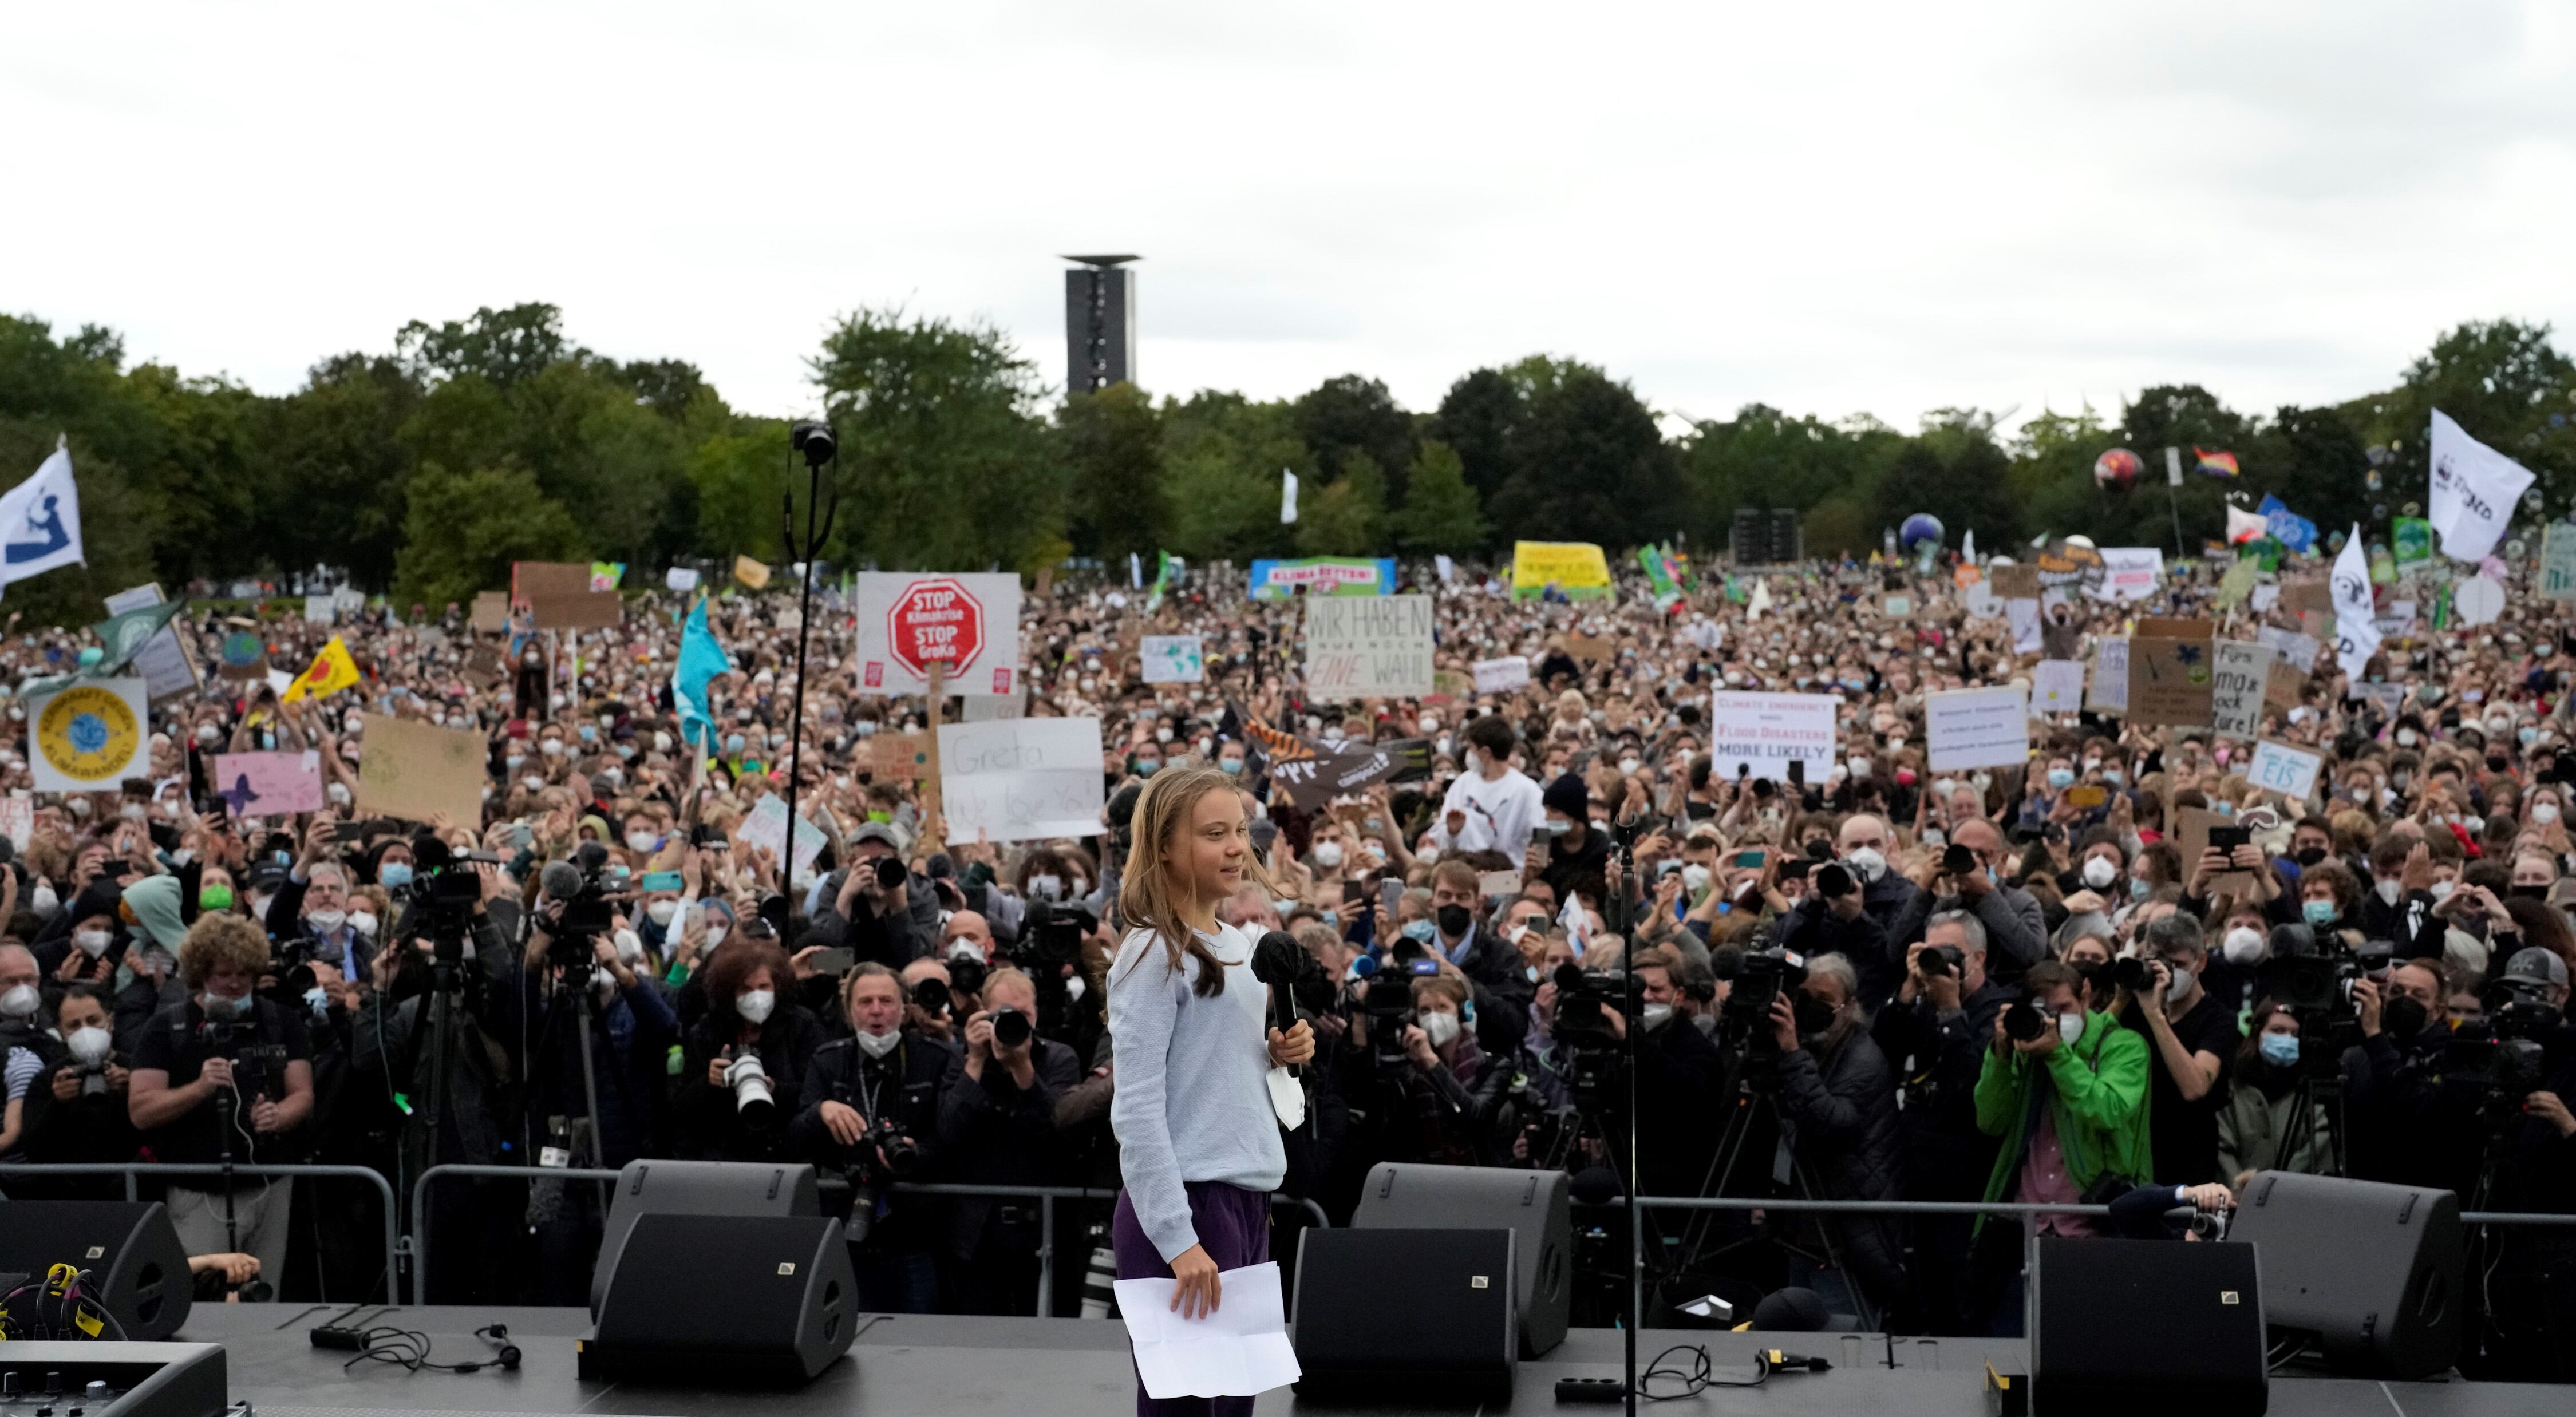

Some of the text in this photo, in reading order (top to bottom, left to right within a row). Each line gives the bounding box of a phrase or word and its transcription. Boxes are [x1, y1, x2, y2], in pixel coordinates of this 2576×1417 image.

[1273, 570, 1315, 581] KLIMA
[913, 590, 956, 611] STOP
[907, 609, 964, 624] Klimakrise
[1307, 597, 1428, 639] WIR HABEN
[915, 625, 958, 646] STOP
[918, 644, 957, 660] GroKo
[1309, 653, 1427, 687] EINE WAHL
[953, 729, 1043, 774] Greta
[1718, 743, 1826, 759] MORE LIKELY
[2262, 760, 2296, 789] EIS
[950, 791, 987, 829] We
